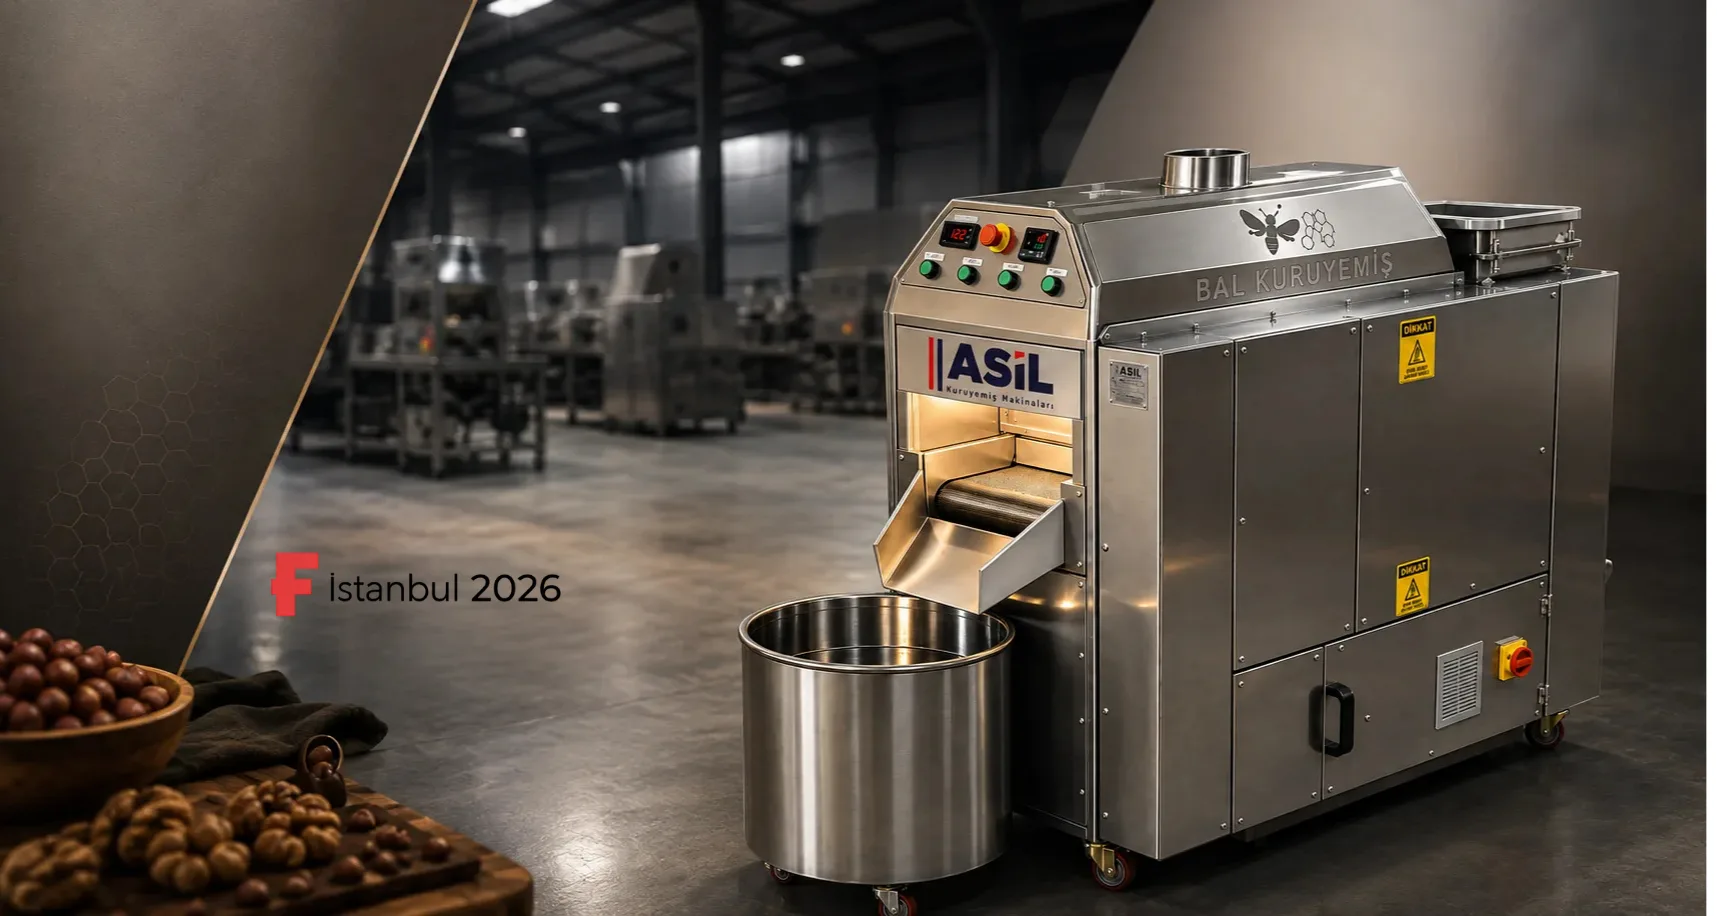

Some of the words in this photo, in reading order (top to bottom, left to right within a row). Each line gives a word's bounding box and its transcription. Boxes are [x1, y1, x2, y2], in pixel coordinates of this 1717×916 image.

[950, 228, 967, 240] 122
[1196, 274, 1245, 302] BAL
[1256, 248, 1393, 293] KURUYEMİŞ
[946, 385, 997, 402] Kuruyemiş
[1002, 394, 1054, 409] Makinaları
